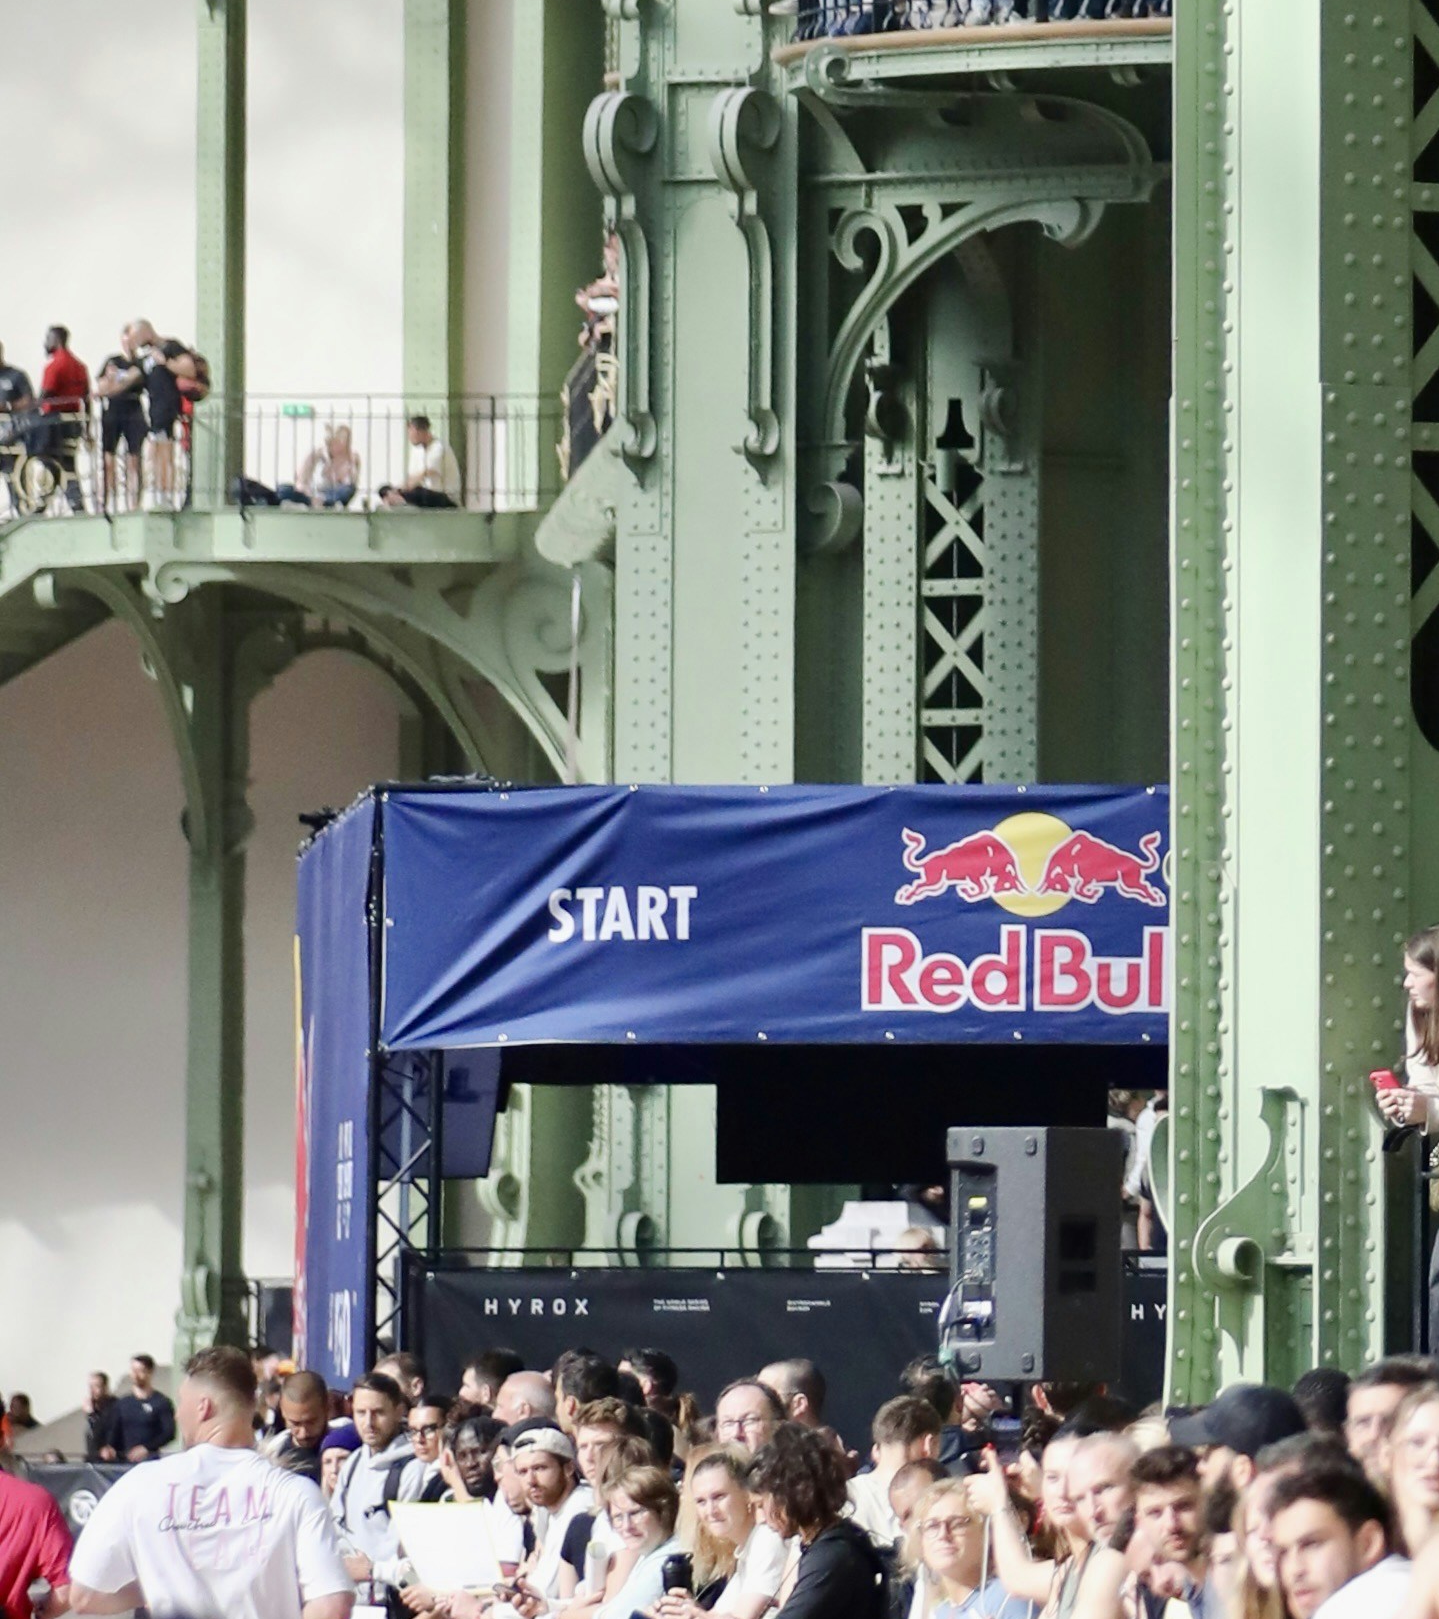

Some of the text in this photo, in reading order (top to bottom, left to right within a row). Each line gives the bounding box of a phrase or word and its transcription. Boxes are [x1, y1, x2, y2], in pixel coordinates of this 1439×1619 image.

[547, 884, 698, 945] START
[861, 927, 1169, 1013] Red Bul
[484, 1298, 590, 1316] HYROX
